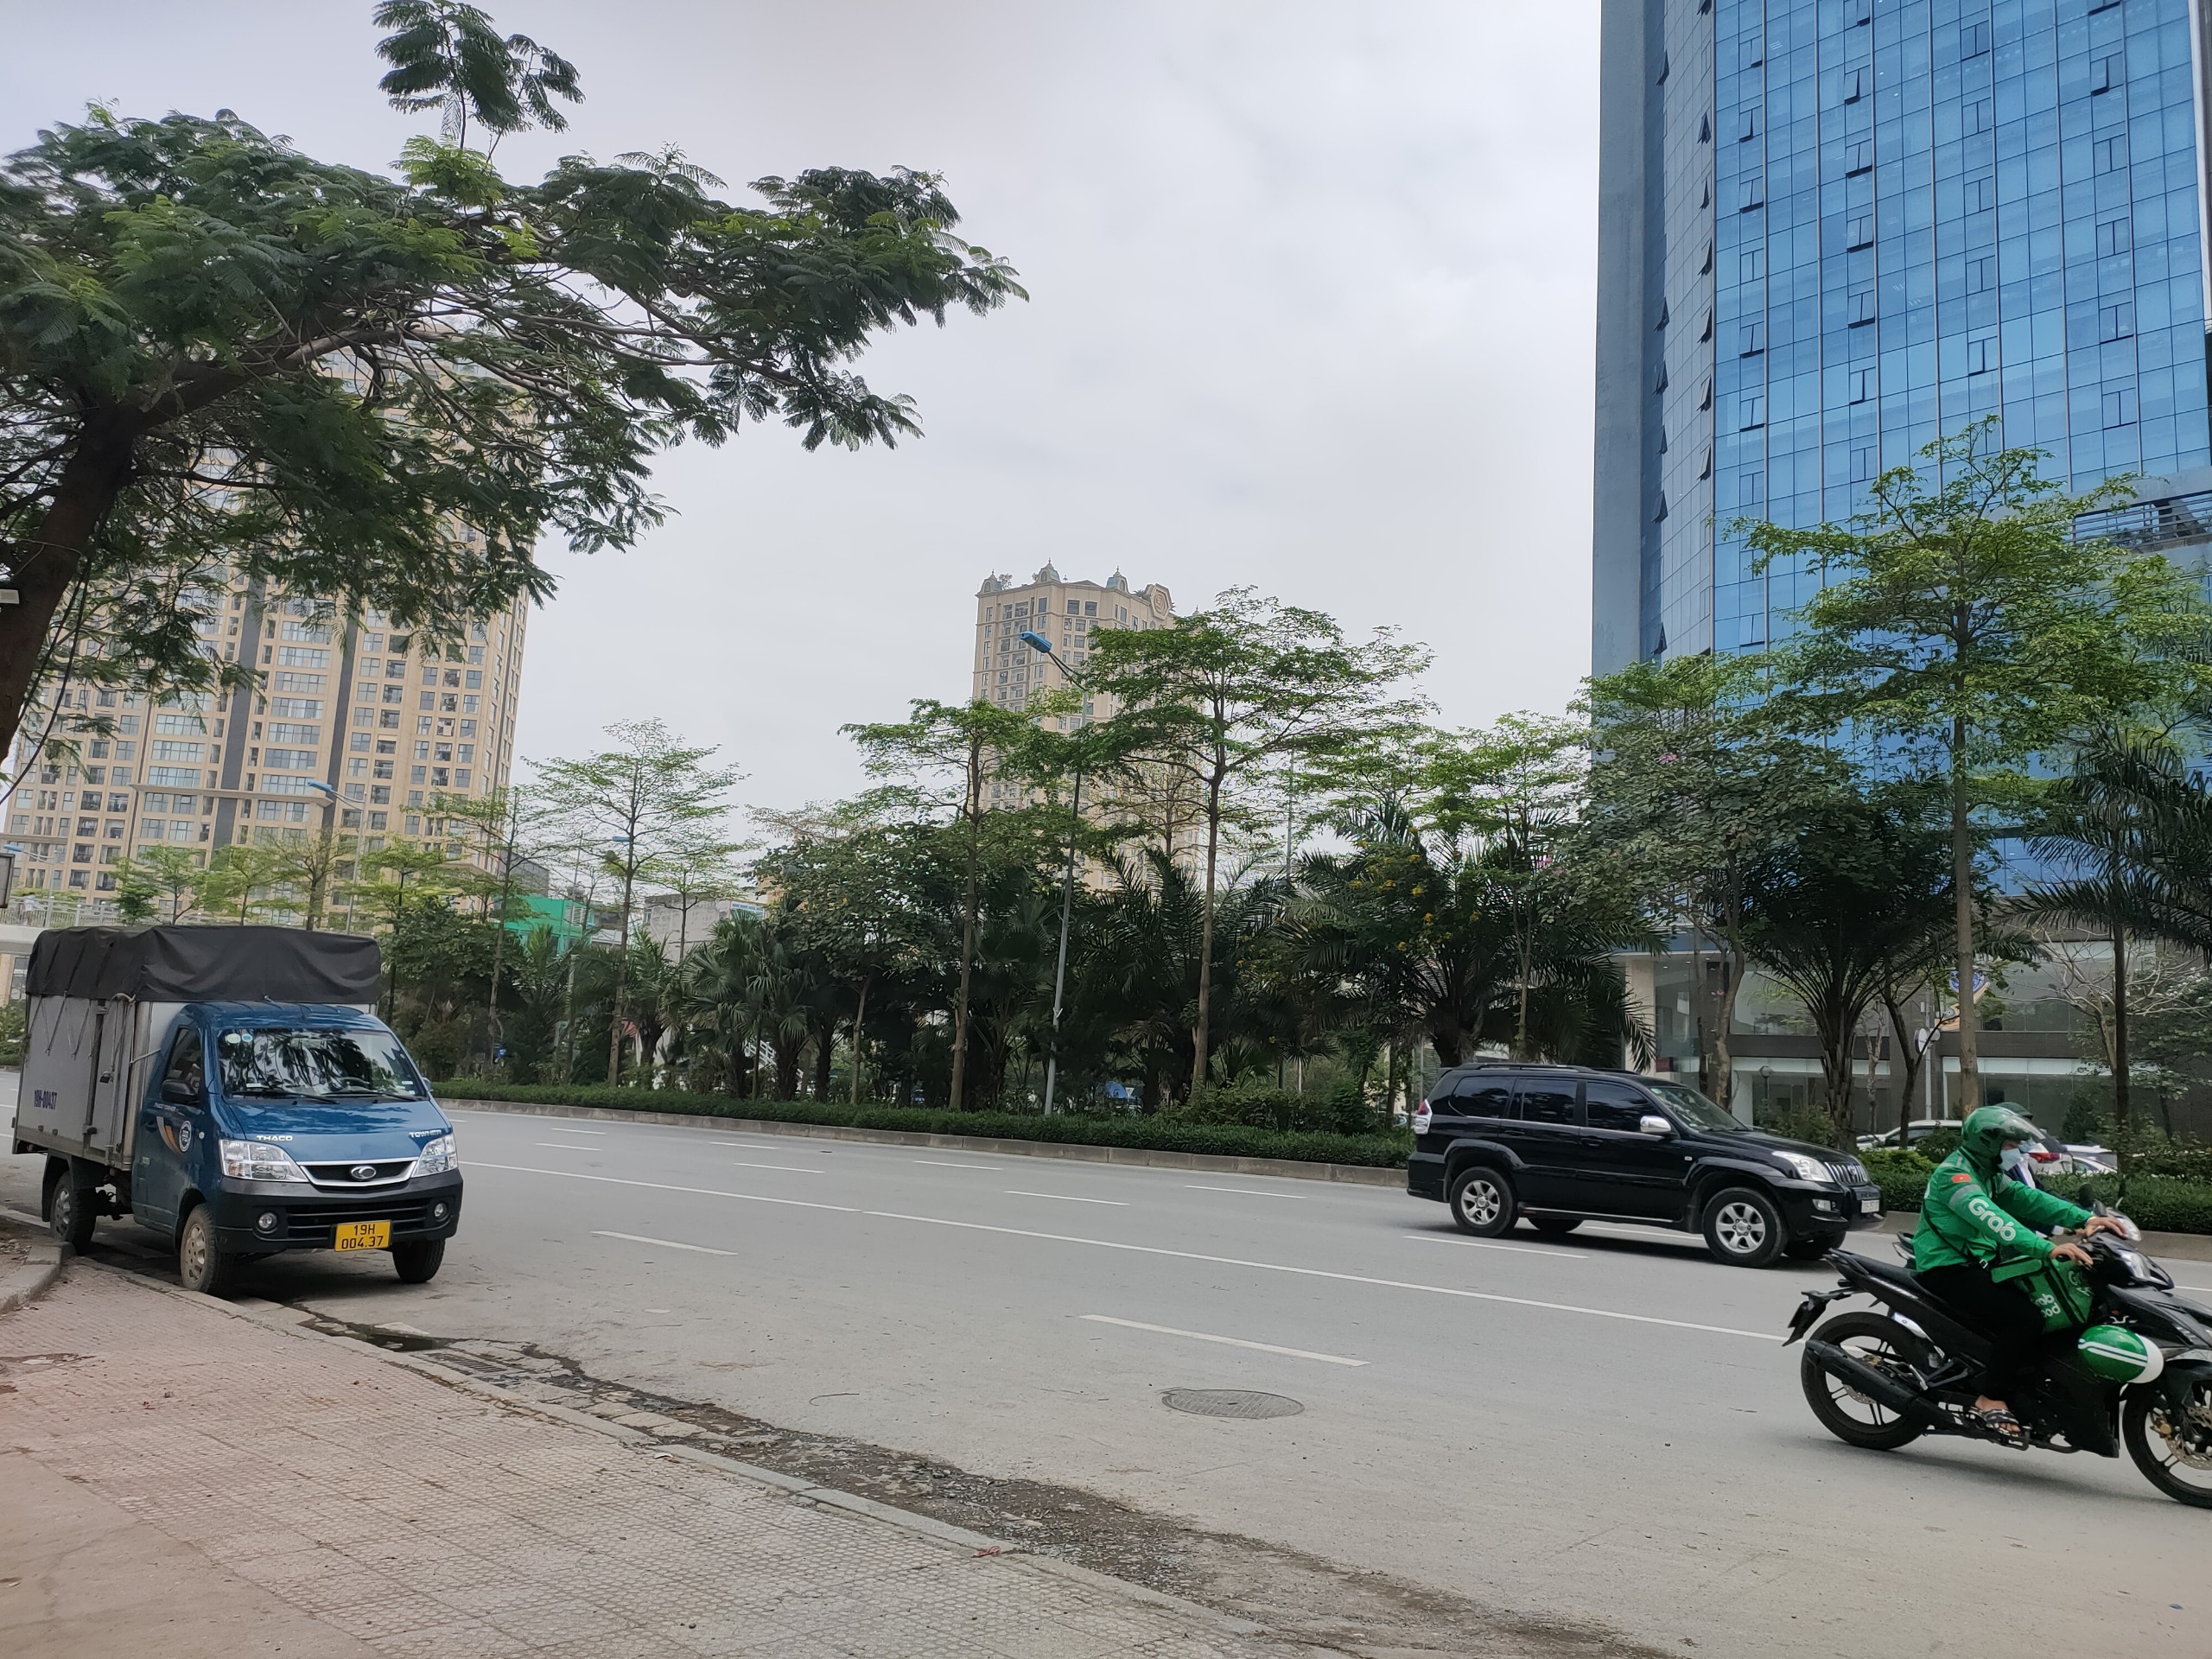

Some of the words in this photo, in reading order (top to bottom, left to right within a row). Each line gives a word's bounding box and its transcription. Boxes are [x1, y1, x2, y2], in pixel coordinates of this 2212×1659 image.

[1968, 1198, 2017, 1242] Grab
[353, 1224, 376, 1236] 19H
[341, 1236, 384, 1249] 004.37
[2033, 1293, 2056, 1307] rab
